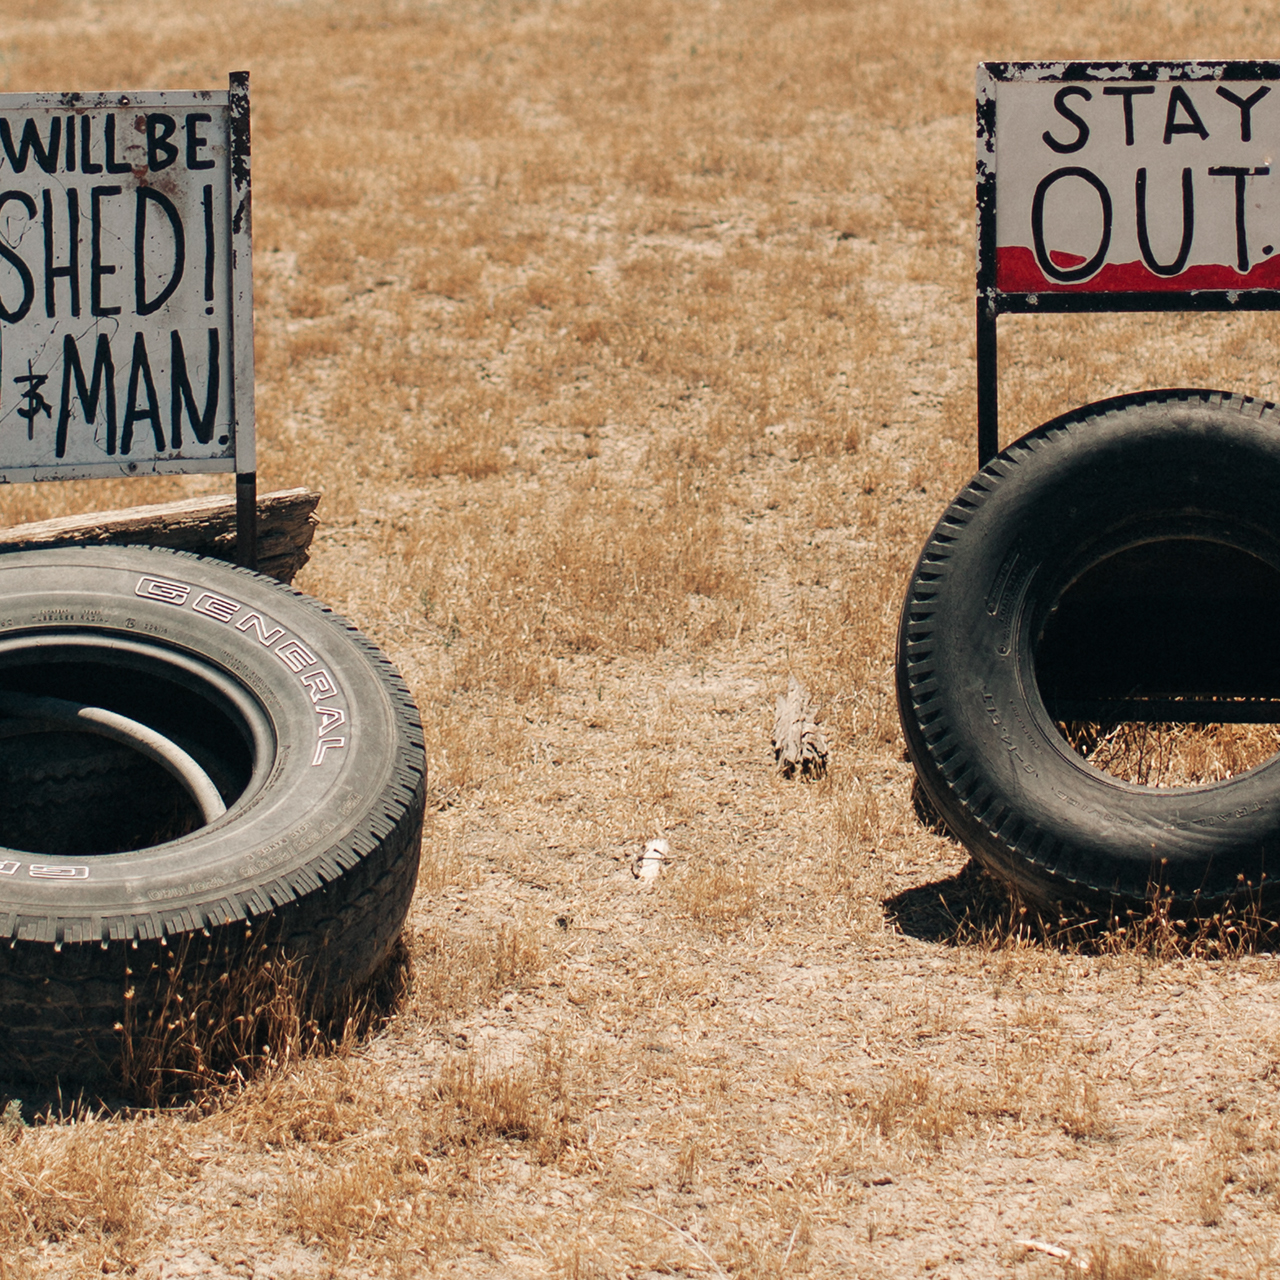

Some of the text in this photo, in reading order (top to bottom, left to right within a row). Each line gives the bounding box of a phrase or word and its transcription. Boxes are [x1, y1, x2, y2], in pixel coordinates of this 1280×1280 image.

[0, 114, 133, 174] WILL
[146, 113, 216, 172] BE
[1042, 85, 1272, 154] STAY
[13, 358, 53, 440] &
[135, 576, 346, 766] GENERAL
